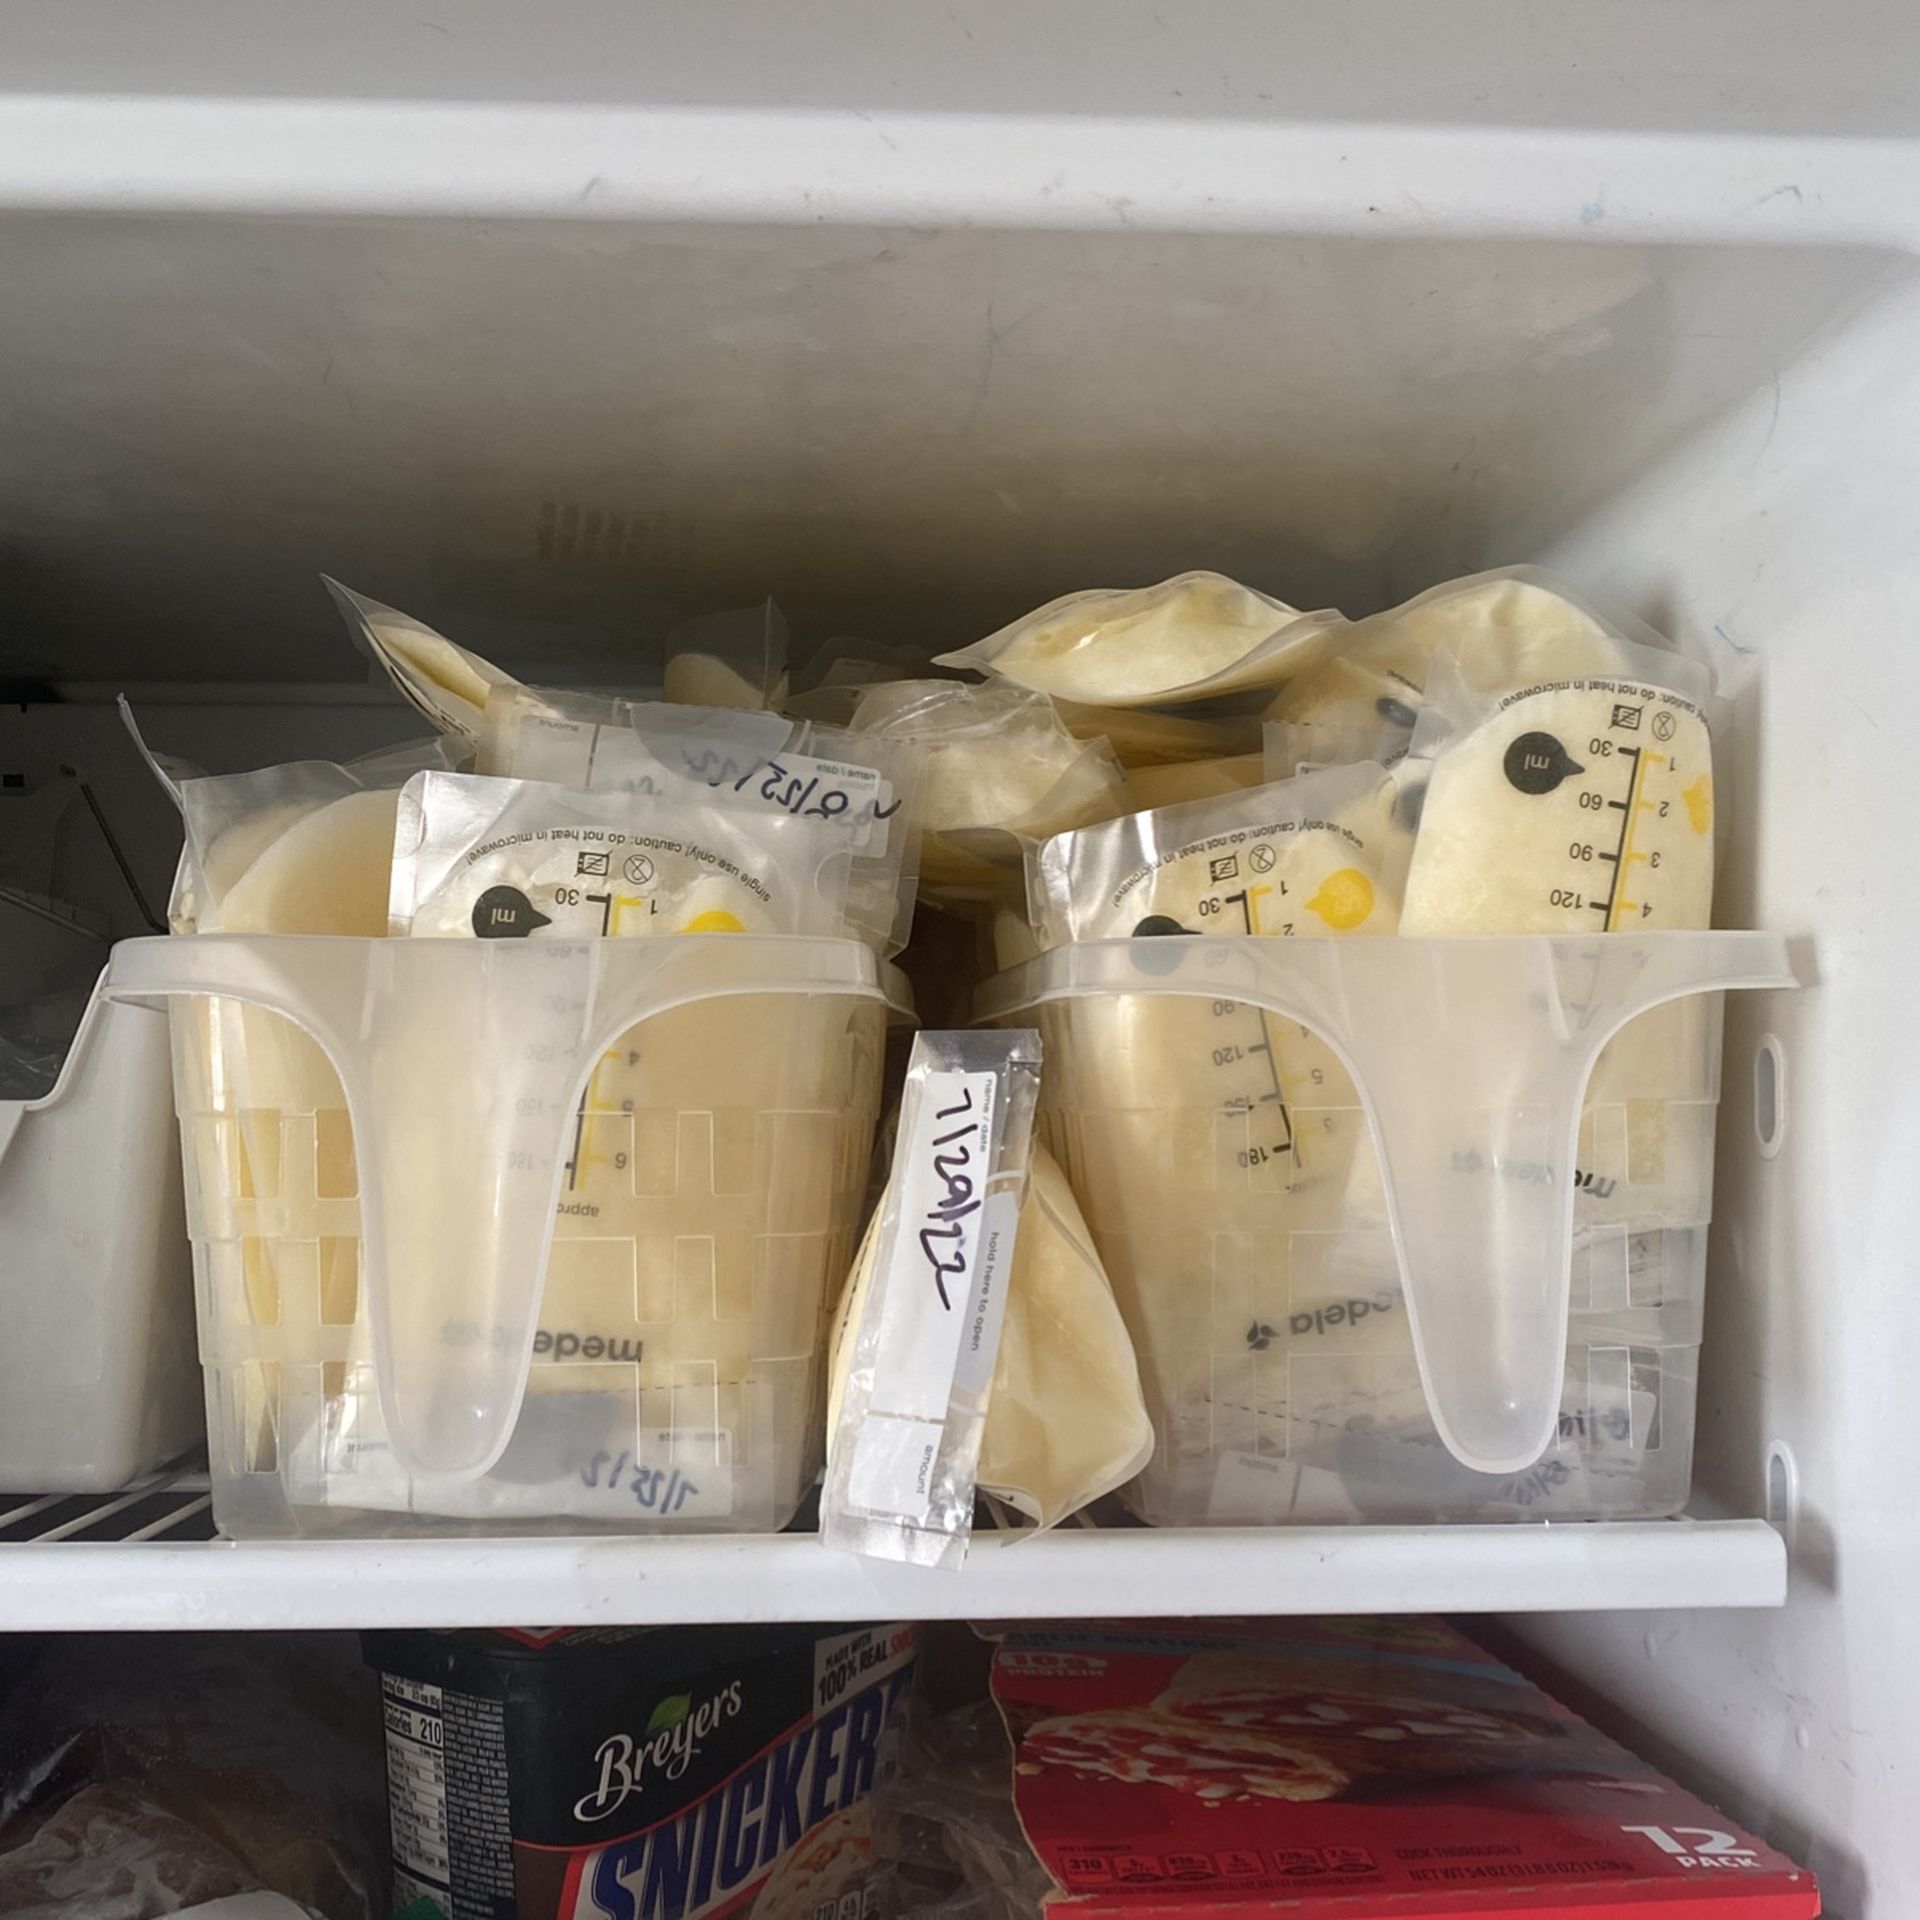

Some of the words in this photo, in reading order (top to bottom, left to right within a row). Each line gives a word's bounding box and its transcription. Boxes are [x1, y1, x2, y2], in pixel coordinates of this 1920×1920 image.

[1498, 681, 1570, 711] microwave!
[1574, 680, 1585, 696] in
[1589, 681, 1615, 698] heat
[1618, 683, 1637, 699] not
[1641, 689, 1656, 703] do
[1589, 738, 1613, 757] 30
[1525, 753, 1551, 772] ml
[1669, 756, 1677, 773] 1
[1579, 792, 1603, 810] 60
[1659, 801, 1670, 817] 2
[1249, 822, 1295, 840] caution:
[1298, 818, 1324, 833] only!
[536, 829, 548, 842] in
[552, 830, 580, 842] heat
[583, 830, 604, 842] not
[608, 832, 625, 845] do
[1206, 836, 1227, 852] not
[1229, 831, 1246, 846] do
[464, 833, 532, 866] microwave!
[630, 836, 682, 853] caution:
[1178, 842, 1205, 861] heat
[1570, 843, 1594, 861] 90
[685, 845, 716, 864] only!
[1164, 852, 1176, 866] in
[1651, 852, 1661, 869] 3
[718, 859, 740, 876] use
[555, 888, 580, 904] 30
[741, 872, 771, 903] single
[1280, 881, 1288, 896] 1
[650, 899, 659, 915] 1
[1198, 897, 1221, 916] 30
[1550, 889, 1583, 910] 120
[491, 908, 517, 925] ml
[1642, 902, 1652, 918] 4
[1212, 999, 1236, 1017] 90
[628, 1051, 641, 1066] 4
[1212, 1045, 1244, 1067] 120
[1310, 1069, 1323, 1086] 5
[981, 1079, 994, 1111] name
[979, 1123, 988, 1152] date
[614, 1152, 627, 1169] 6
[1237, 1146, 1269, 1168] 180
[987, 1231, 1000, 1259] hold
[981, 1263, 995, 1295] here
[980, 1298, 989, 1312] to
[970, 1316, 985, 1351] open
[916, 1443, 933, 1495] amount
[826, 1644, 849, 1670] MADE
[819, 1656, 857, 1706] 100%
[859, 1640, 889, 1674] REAL
[1007, 1669, 1105, 1677] PROTEIN
[420, 1718, 441, 1745] 210
[572, 1679, 743, 1822] Breyers
[1620, 1825, 1757, 1857] 12
[1675, 1855, 1761, 1869] PACK
[1408, 1868, 1438, 1881] NET
